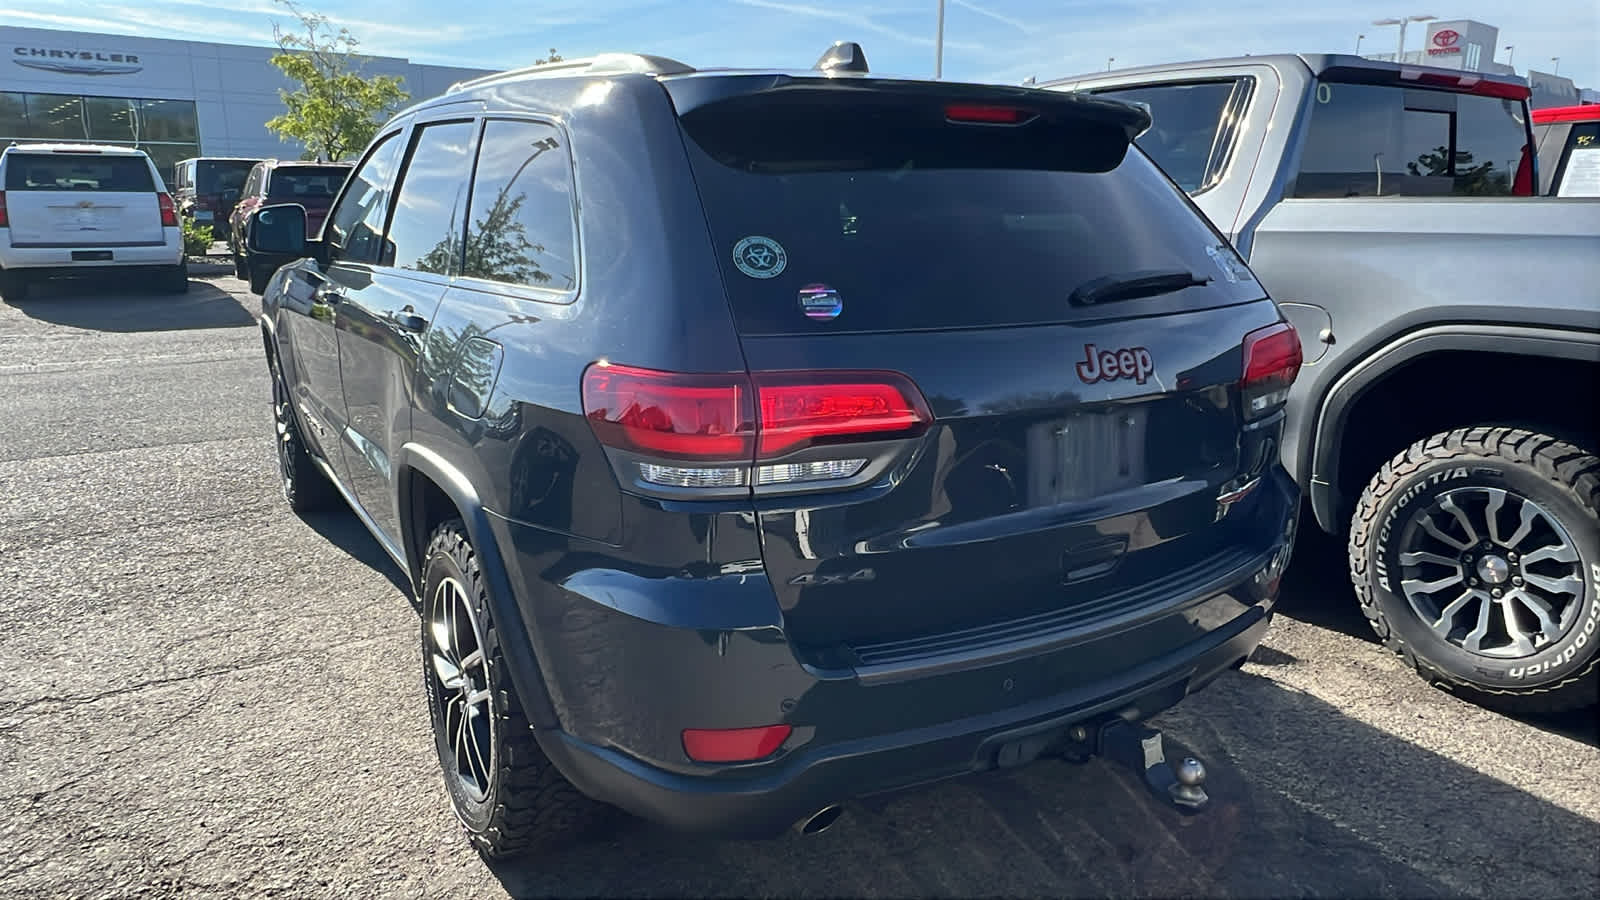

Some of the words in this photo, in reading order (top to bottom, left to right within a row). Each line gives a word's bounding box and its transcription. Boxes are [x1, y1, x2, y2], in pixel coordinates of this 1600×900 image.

[13, 47, 139, 63] CHRYSLER
[1075, 343, 1154, 385] Jeep
[1376, 480, 1427, 592] All-Terrain
[1429, 467, 1468, 485] T/A
